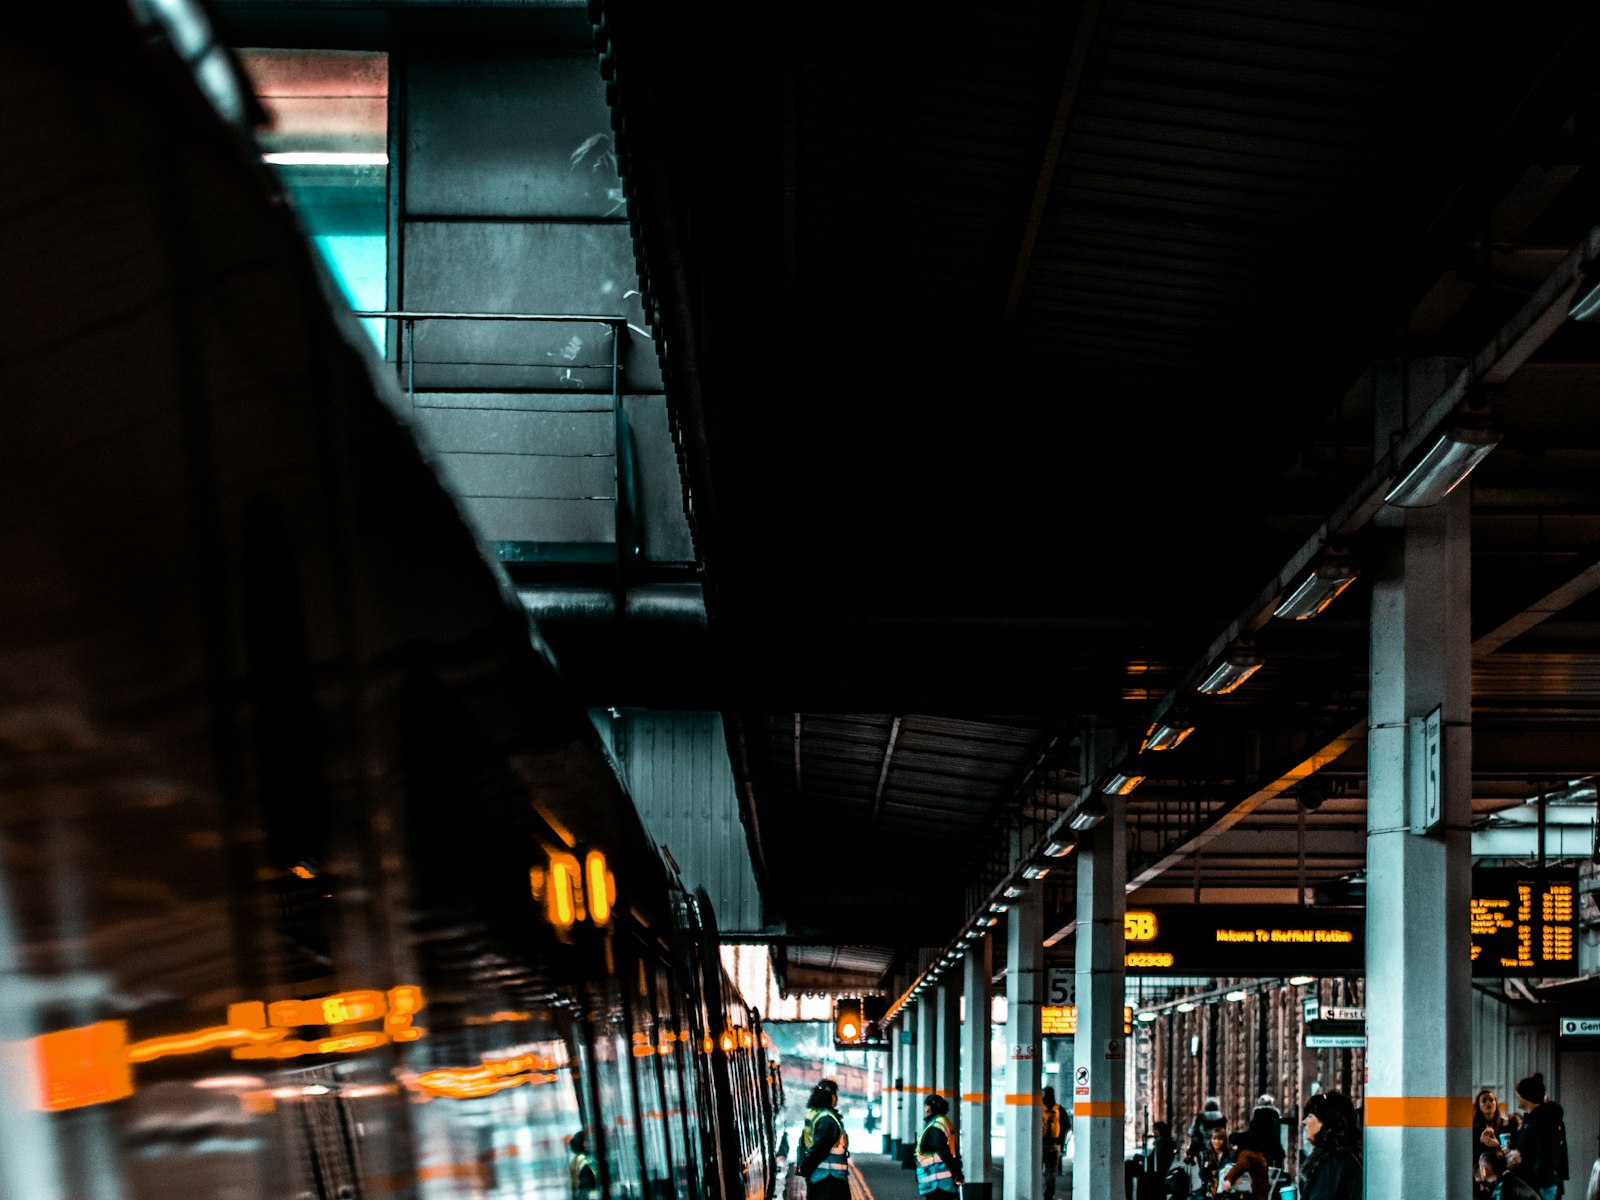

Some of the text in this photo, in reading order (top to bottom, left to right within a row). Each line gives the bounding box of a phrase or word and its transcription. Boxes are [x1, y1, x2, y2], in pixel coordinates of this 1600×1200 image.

[1124, 912, 1156, 940] 5B
[1216, 929, 1352, 942] Welcome To Sheffield Station
